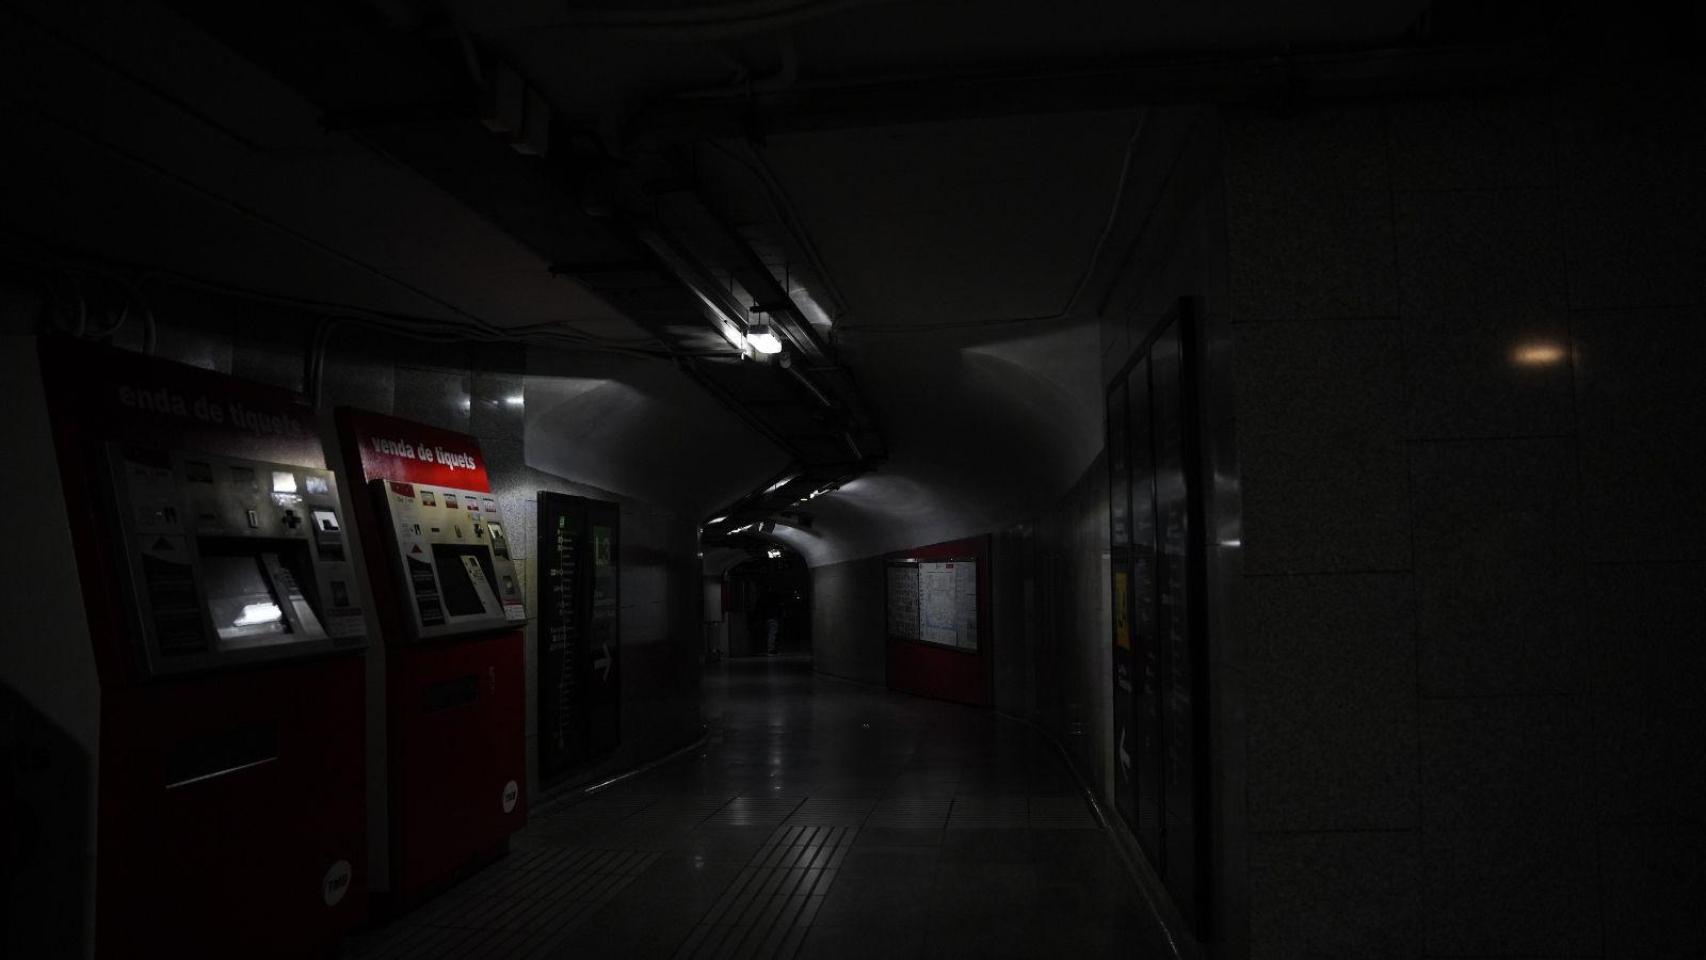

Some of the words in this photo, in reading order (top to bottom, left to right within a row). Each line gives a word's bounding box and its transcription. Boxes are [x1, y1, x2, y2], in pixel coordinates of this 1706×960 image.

[118, 384, 186, 417] enda
[193, 395, 224, 424] de
[229, 402, 302, 435] tiquets
[371, 436, 416, 460] venda
[417, 443, 434, 463] de
[435, 446, 476, 471] tiquets
